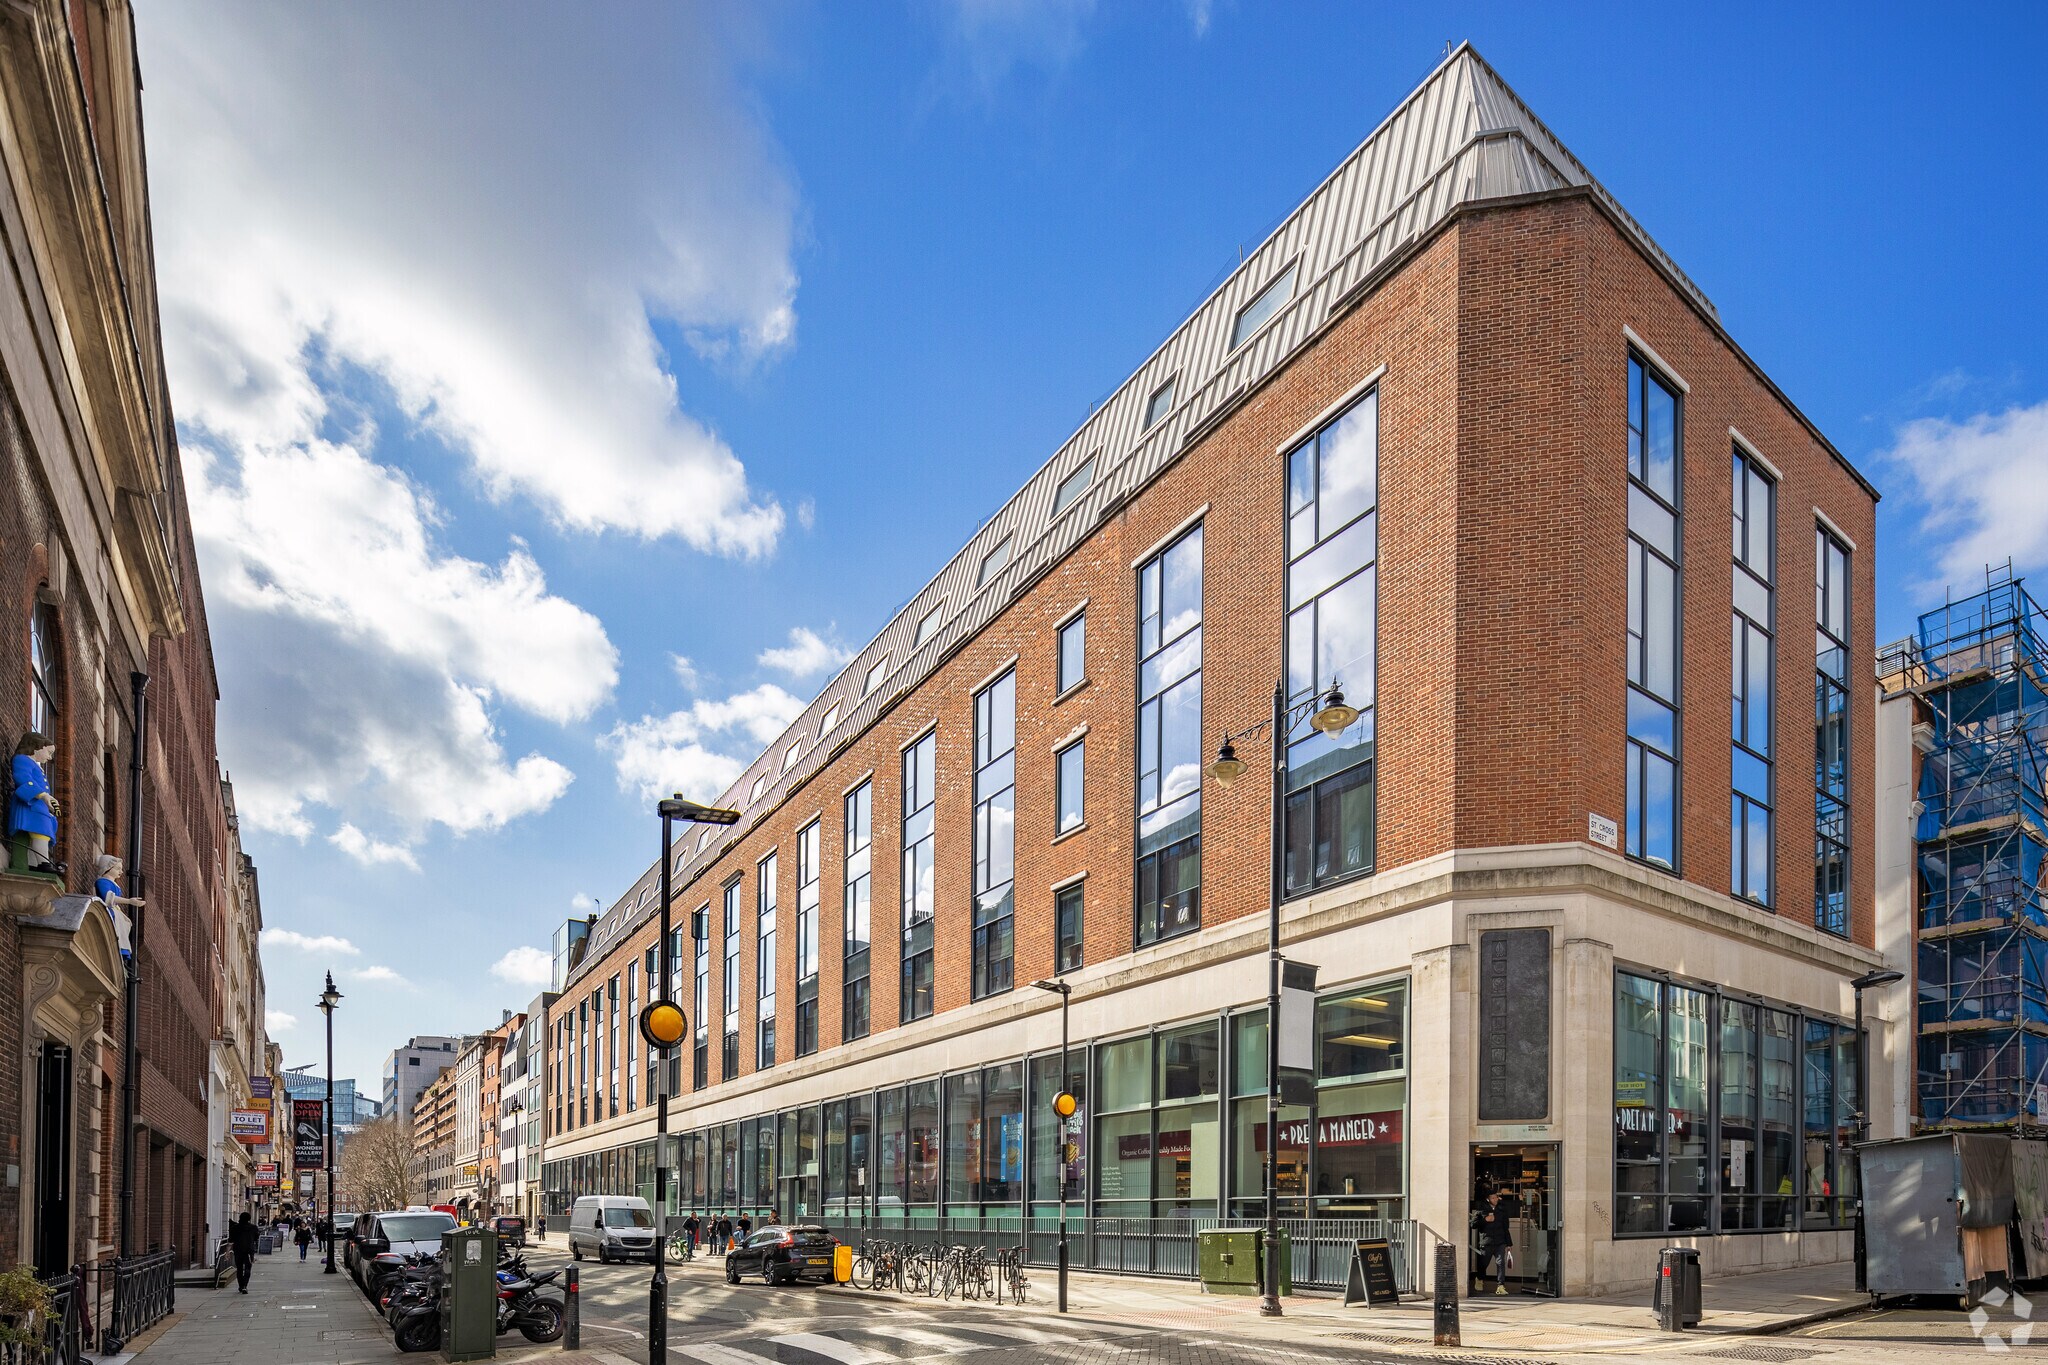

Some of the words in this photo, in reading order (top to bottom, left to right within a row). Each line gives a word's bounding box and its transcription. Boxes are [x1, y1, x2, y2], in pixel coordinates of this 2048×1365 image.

[1591, 830, 1607, 842] STREET
[1599, 824, 1614, 836] CROSS
[1621, 1107, 1640, 1131] PRET
[1641, 1111, 1647, 1131] A
[1290, 1124, 1309, 1145] PRE
[1319, 1123, 1327, 1143] A
[1330, 1118, 1376, 1142] MANGER
